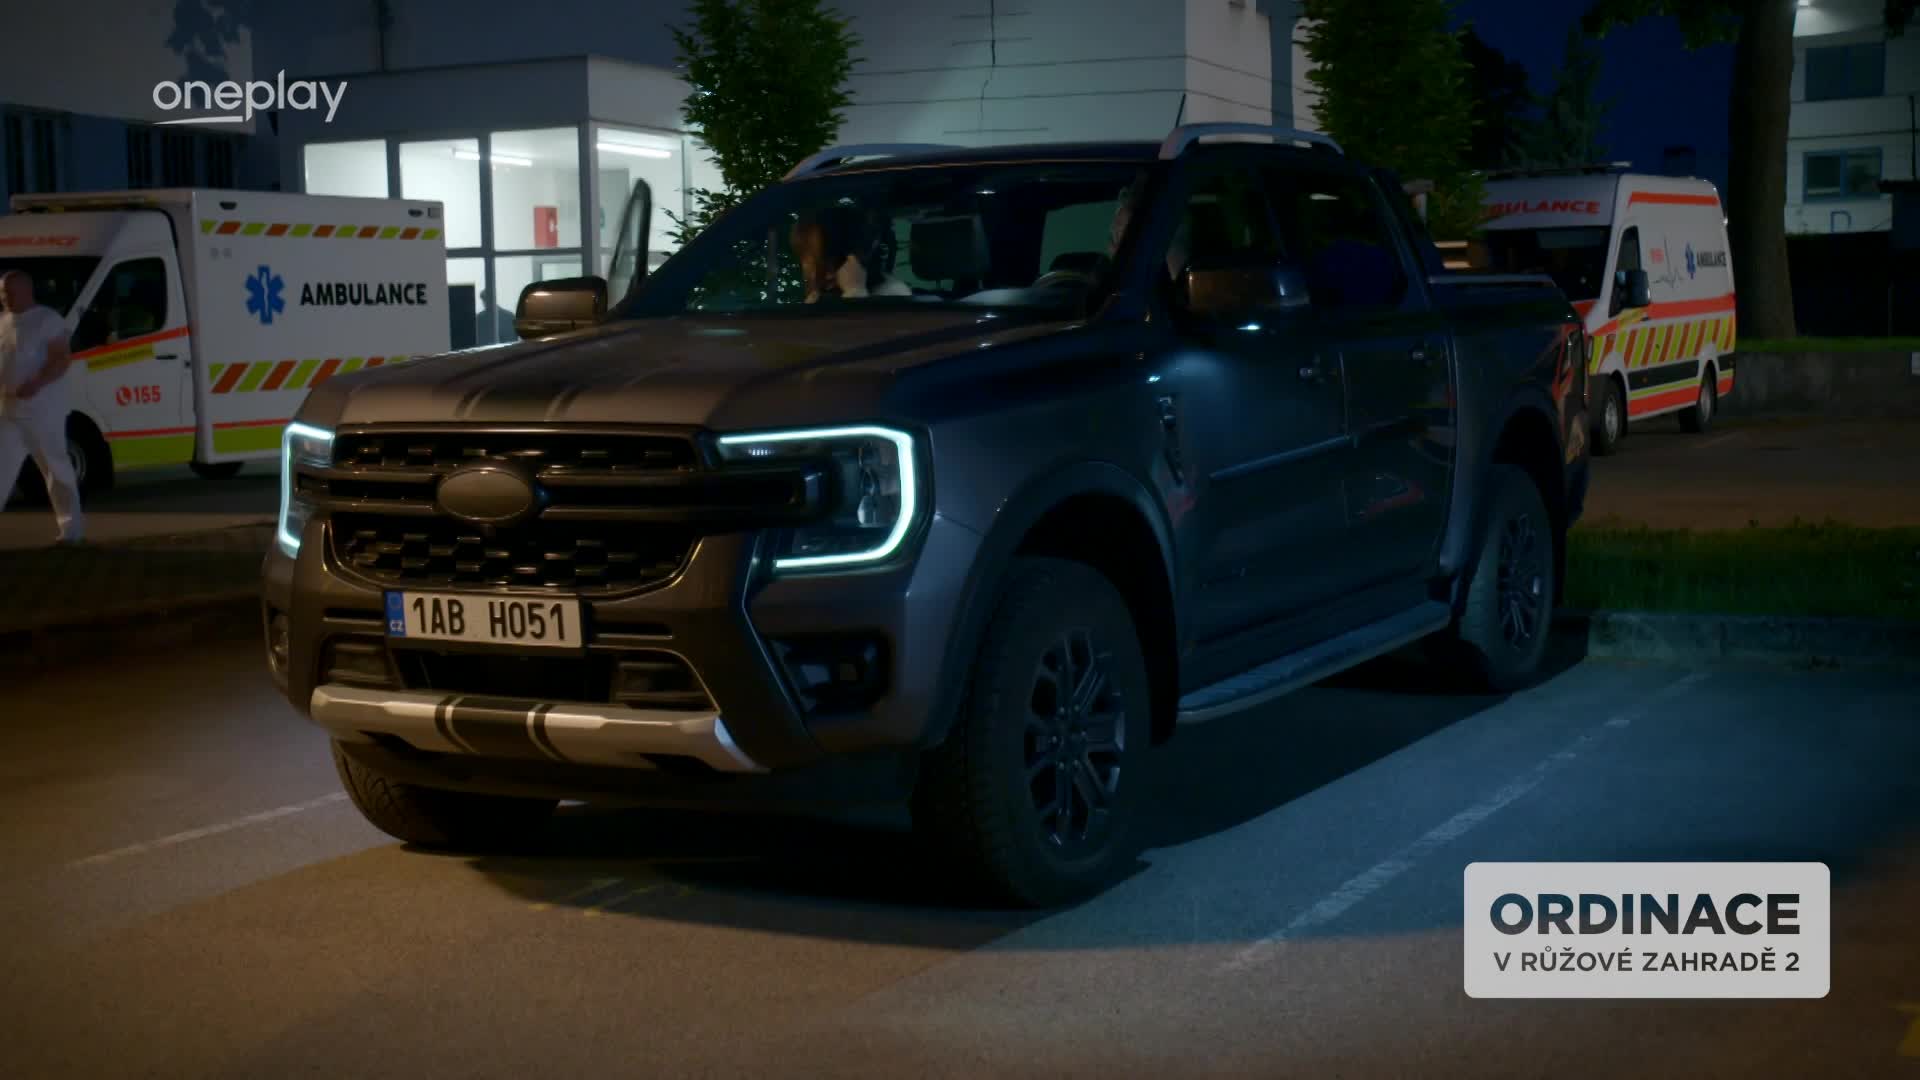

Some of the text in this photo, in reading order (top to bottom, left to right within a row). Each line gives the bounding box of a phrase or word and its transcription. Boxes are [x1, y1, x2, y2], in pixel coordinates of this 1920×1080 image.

[300, 282, 428, 306] AMBULANCE
[134, 386, 161, 403] 155
[413, 597, 564, 640] 1AB H051
